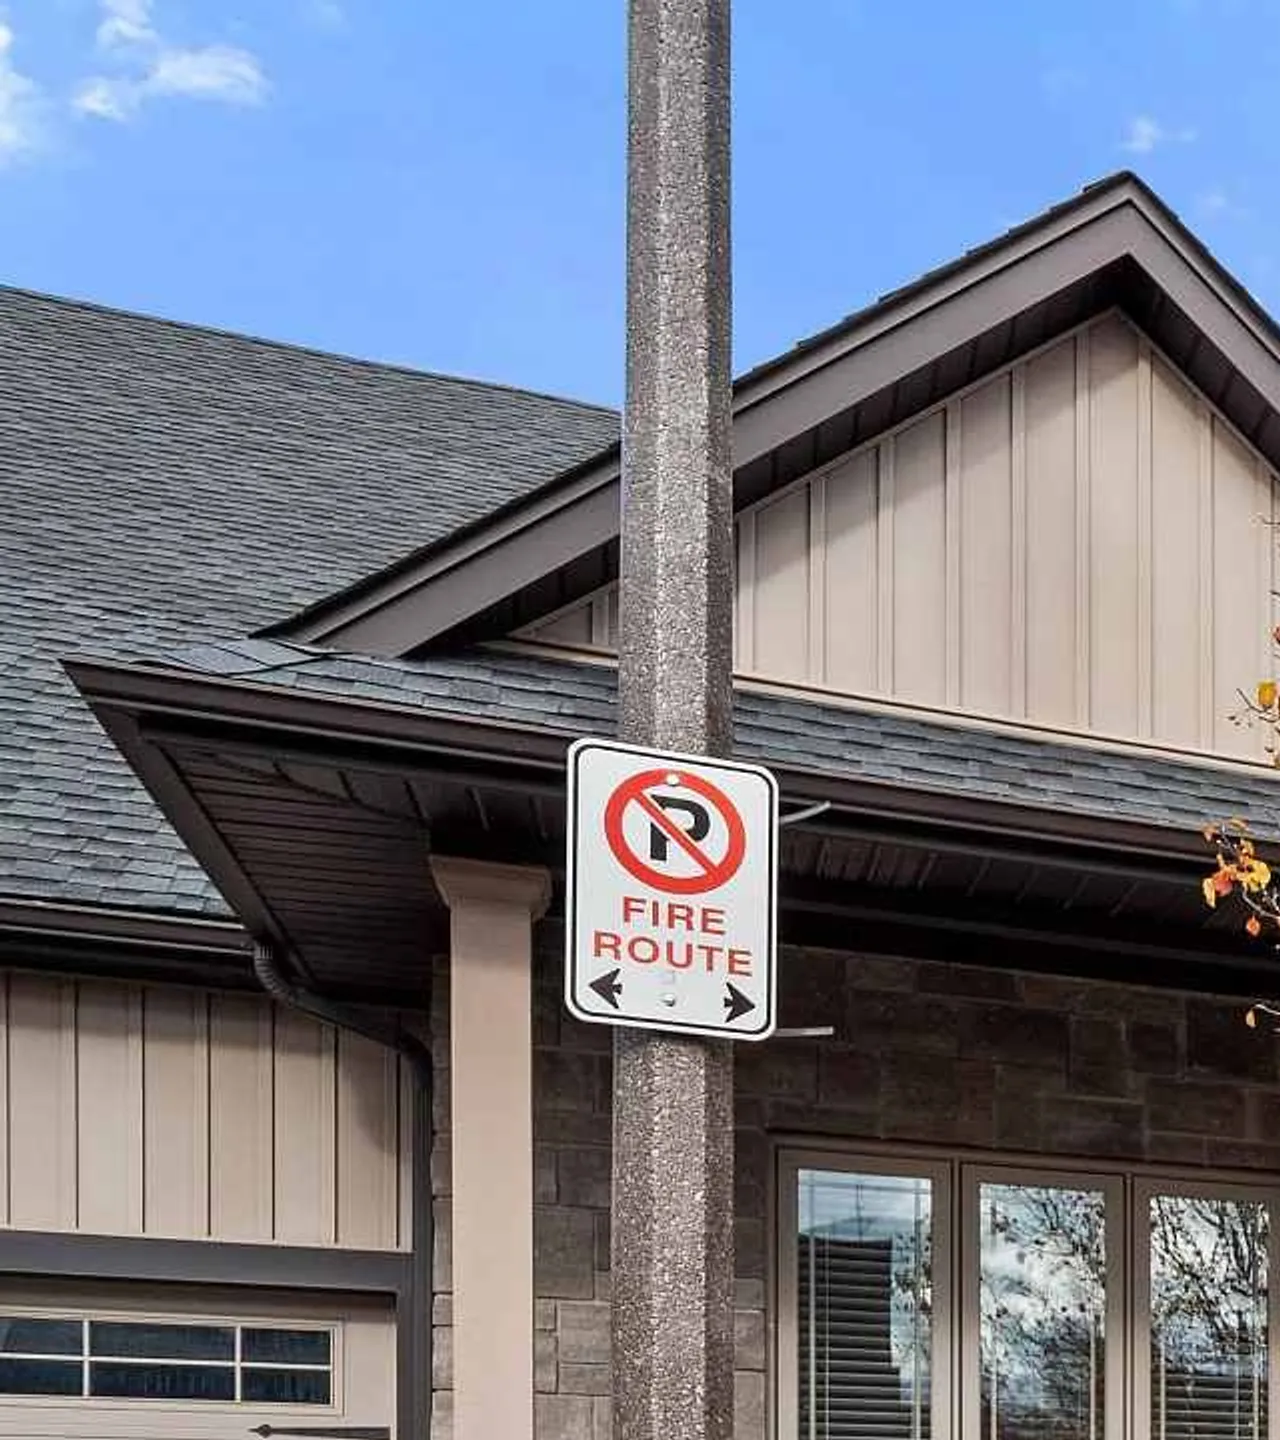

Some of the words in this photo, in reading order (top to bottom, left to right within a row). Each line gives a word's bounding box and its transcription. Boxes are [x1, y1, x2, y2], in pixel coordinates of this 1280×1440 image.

[649, 795, 711, 862] P
[622, 897, 726, 935] FIRE
[593, 931, 754, 977] ROUTE
